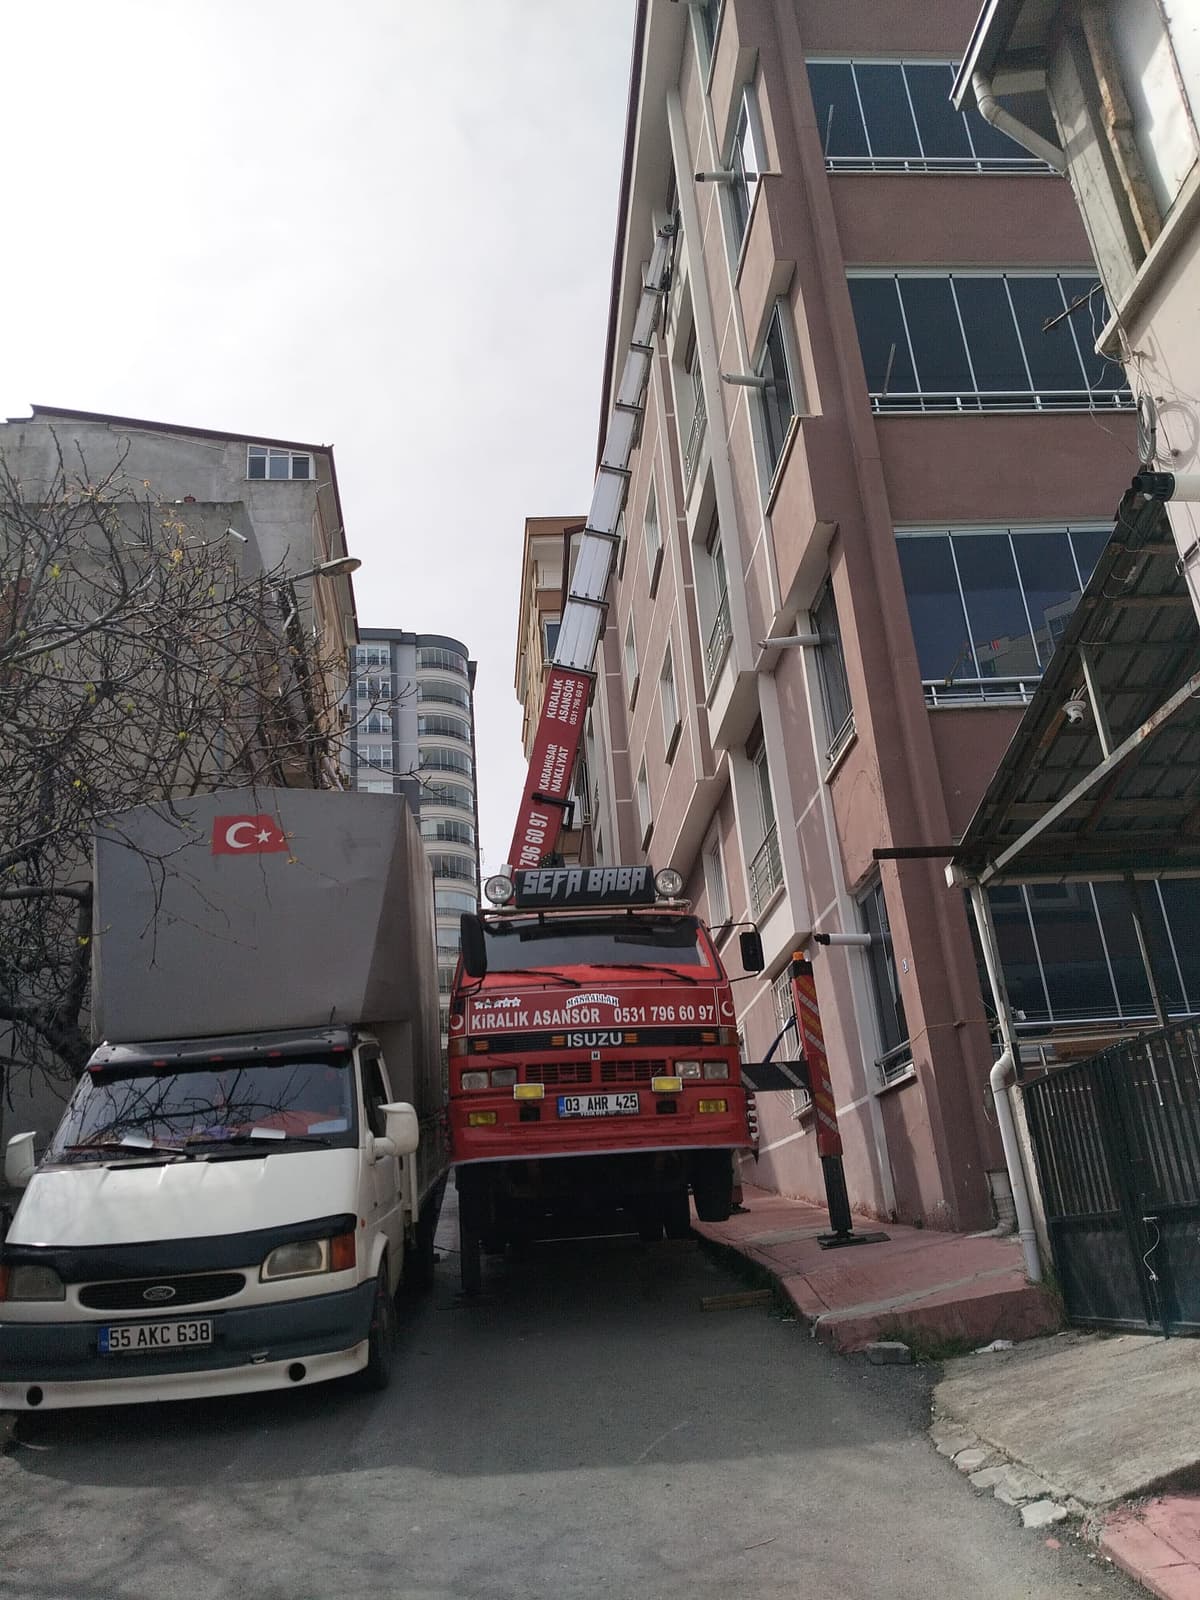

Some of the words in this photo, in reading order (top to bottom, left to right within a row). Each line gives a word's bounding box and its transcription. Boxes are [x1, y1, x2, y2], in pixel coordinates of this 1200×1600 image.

[558, 679, 576, 722] ASANSÖR
[528, 811, 549, 828] 97
[524, 828, 545, 844] 60
[519, 845, 541, 867] 796
[522, 870, 583, 899] SEFA
[587, 867, 647, 897] BABA
[533, 1005, 601, 1026] ASANSÖR
[614, 1006, 646, 1023] 0531
[650, 1005, 675, 1021] 796
[679, 1004, 695, 1020] 60
[698, 1004, 714, 1020] 97
[567, 1032, 623, 1047] ISUZU
[565, 1098, 580, 1112] 03
[587, 1096, 608, 1111] AHR
[616, 1094, 637, 1109] 425
[110, 1328, 131, 1348] 55
[137, 1326, 170, 1347] AKC
[177, 1322, 210, 1342] 638
